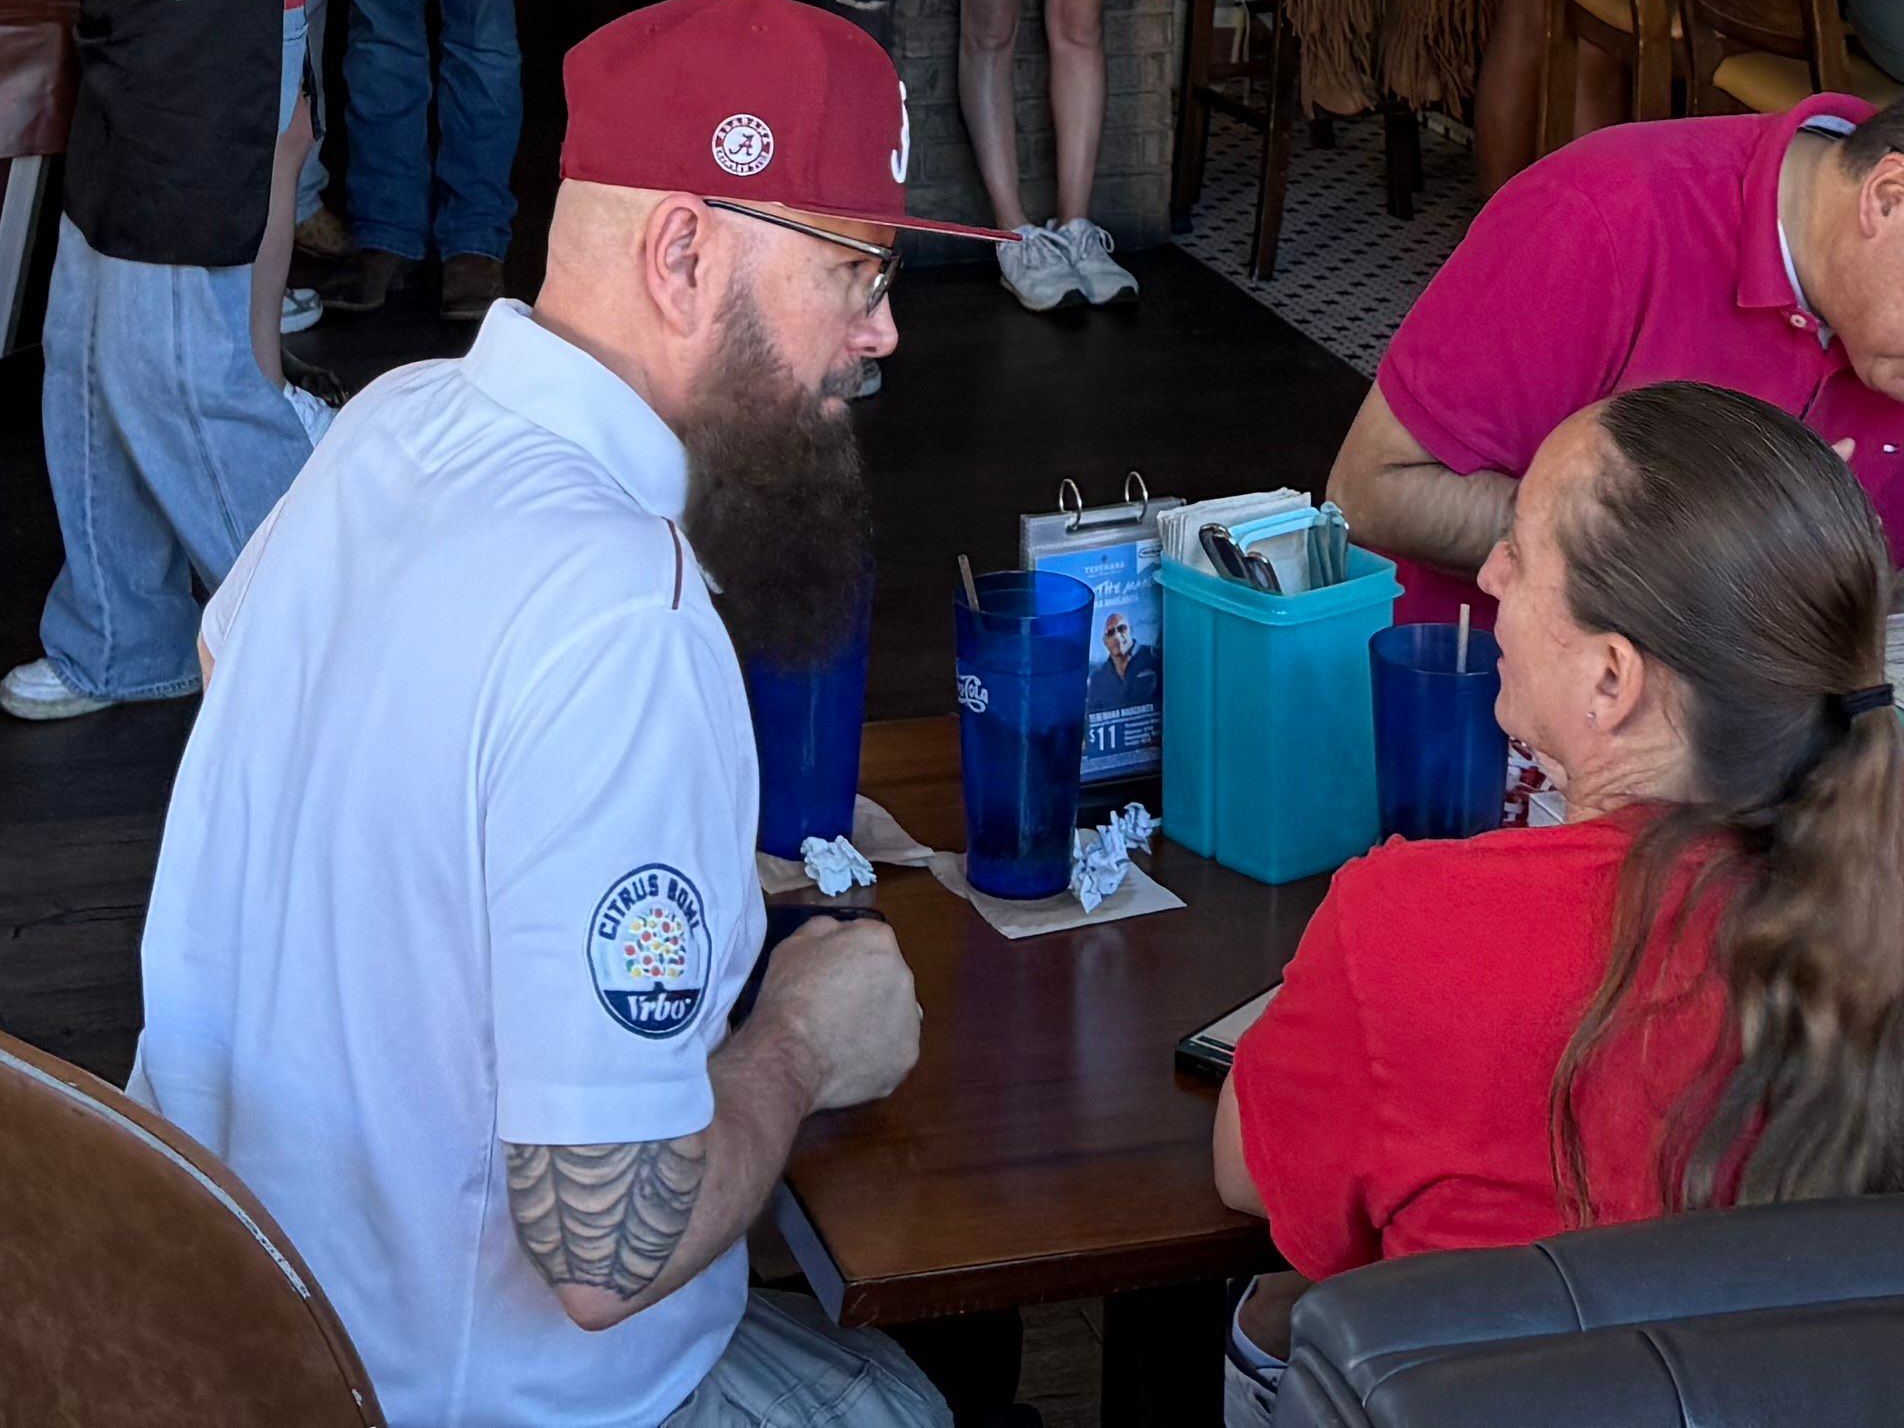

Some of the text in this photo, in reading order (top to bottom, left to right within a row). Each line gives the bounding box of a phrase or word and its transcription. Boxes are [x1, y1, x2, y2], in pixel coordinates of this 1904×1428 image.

[1089, 724, 1116, 751] $11
[597, 872, 704, 942] CITRUS BOWL
[625, 991, 693, 1025] Vrbo
